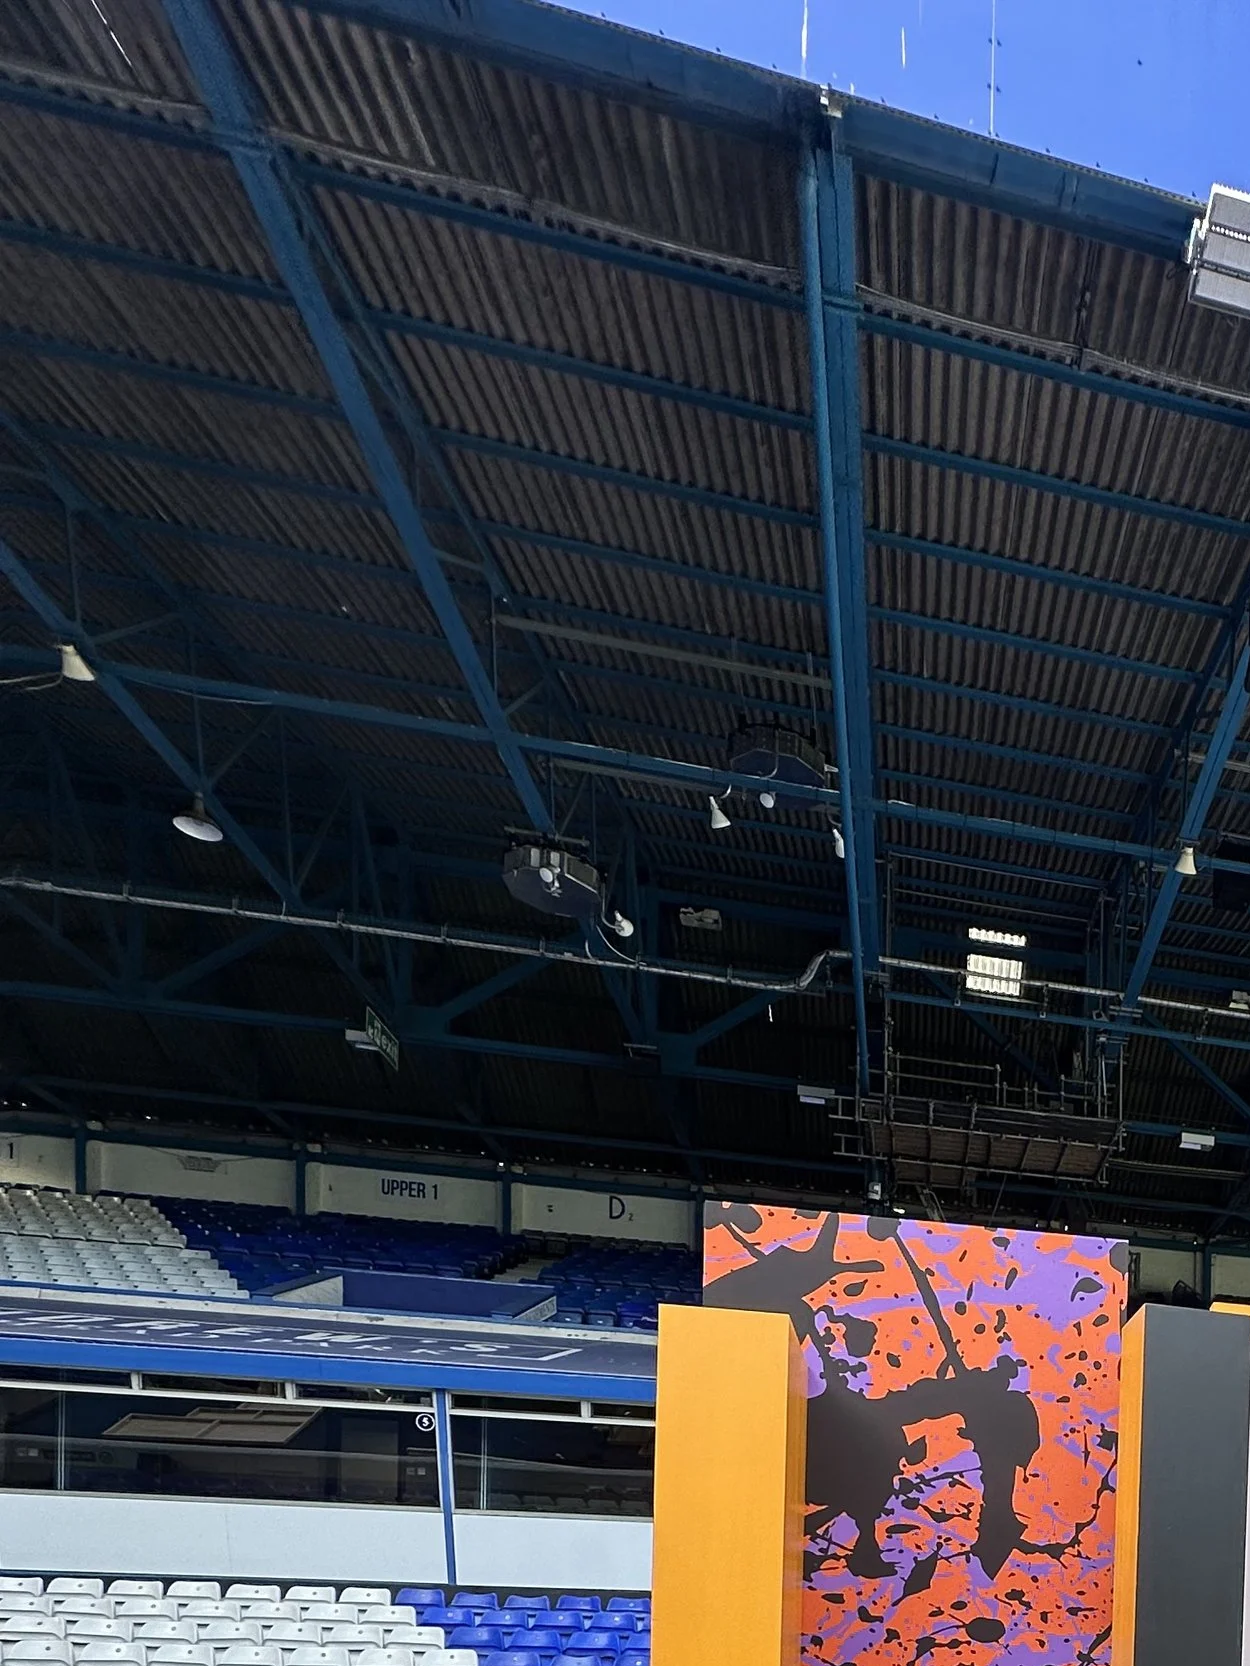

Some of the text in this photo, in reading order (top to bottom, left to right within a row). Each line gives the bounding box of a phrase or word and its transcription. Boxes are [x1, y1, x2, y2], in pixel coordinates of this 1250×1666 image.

[381, 1178, 438, 1200] UPPER 1
[609, 1195, 625, 1219] D
[422, 1416, 430, 1427] 5
